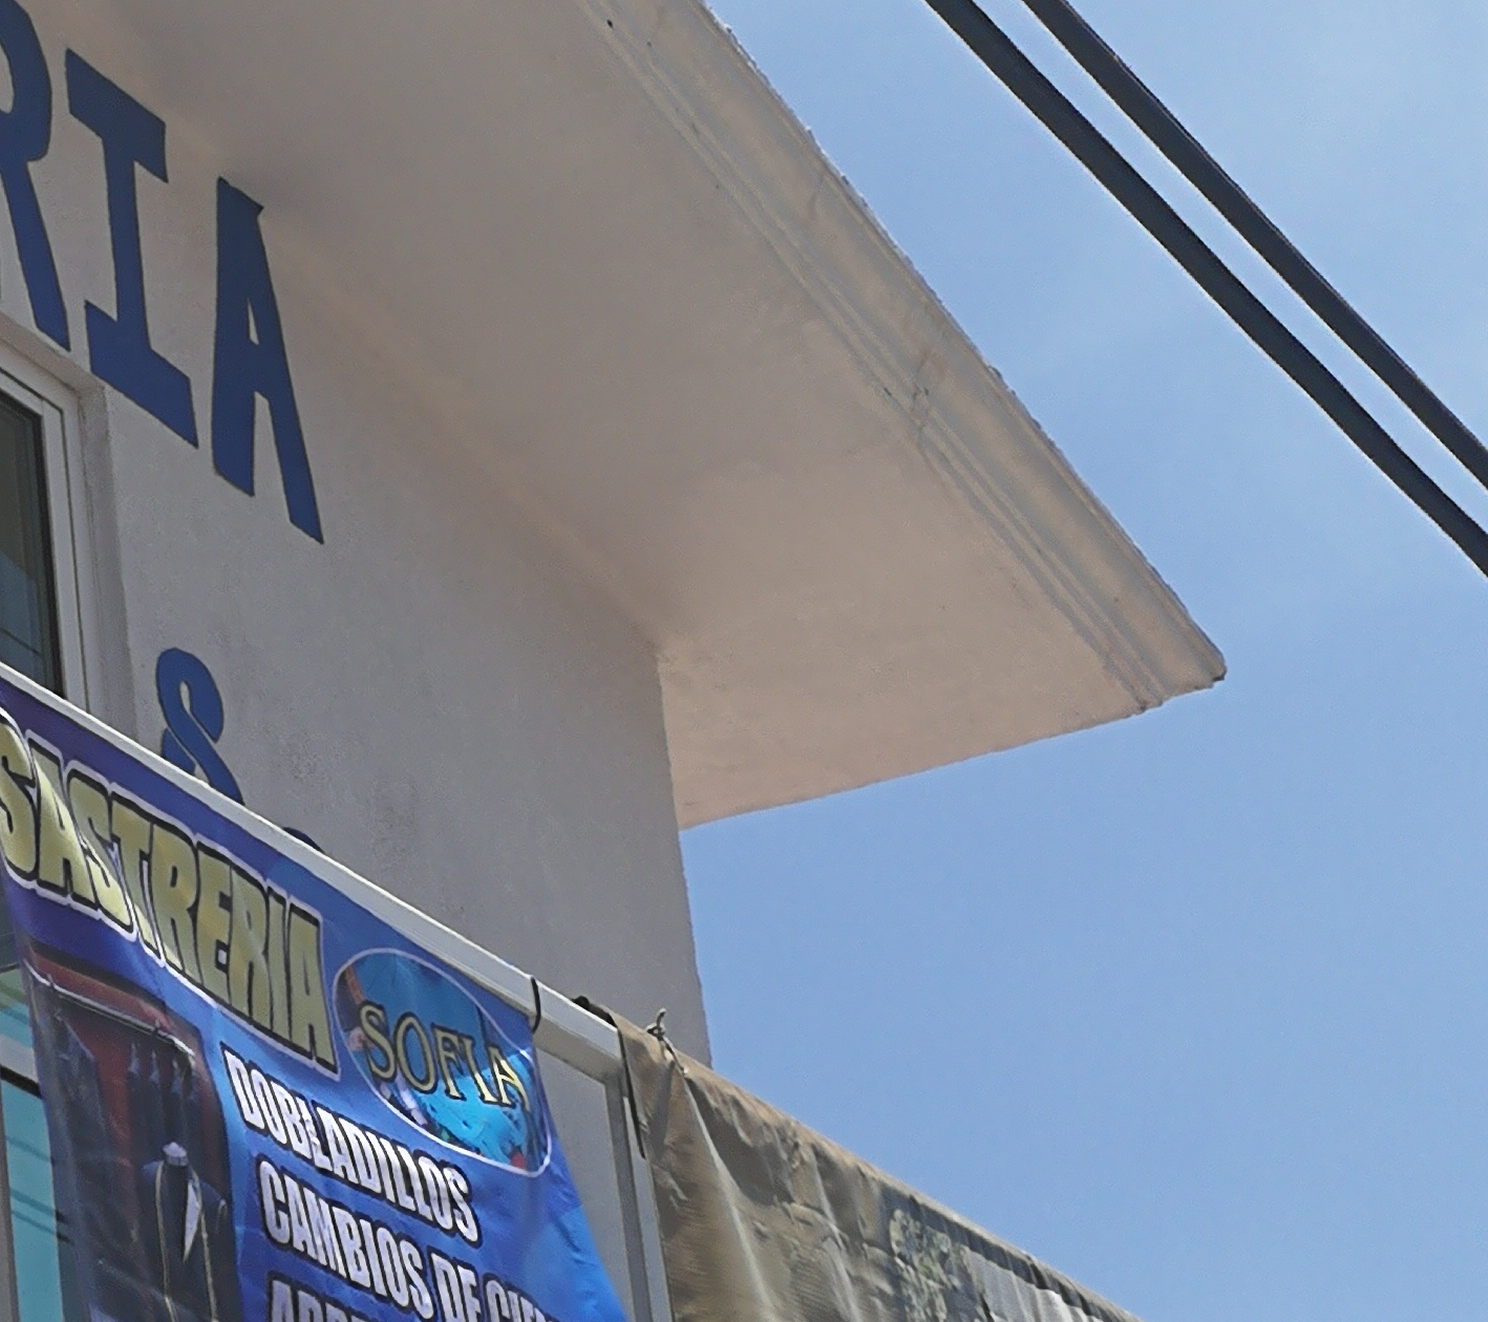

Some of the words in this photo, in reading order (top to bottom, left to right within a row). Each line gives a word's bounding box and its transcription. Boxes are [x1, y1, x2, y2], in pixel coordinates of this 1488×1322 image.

[358, 1002, 532, 1109] SOFIA
[222, 1043, 481, 1244] DOBLADILLOS
[257, 1159, 435, 1320] CAMBIOS
